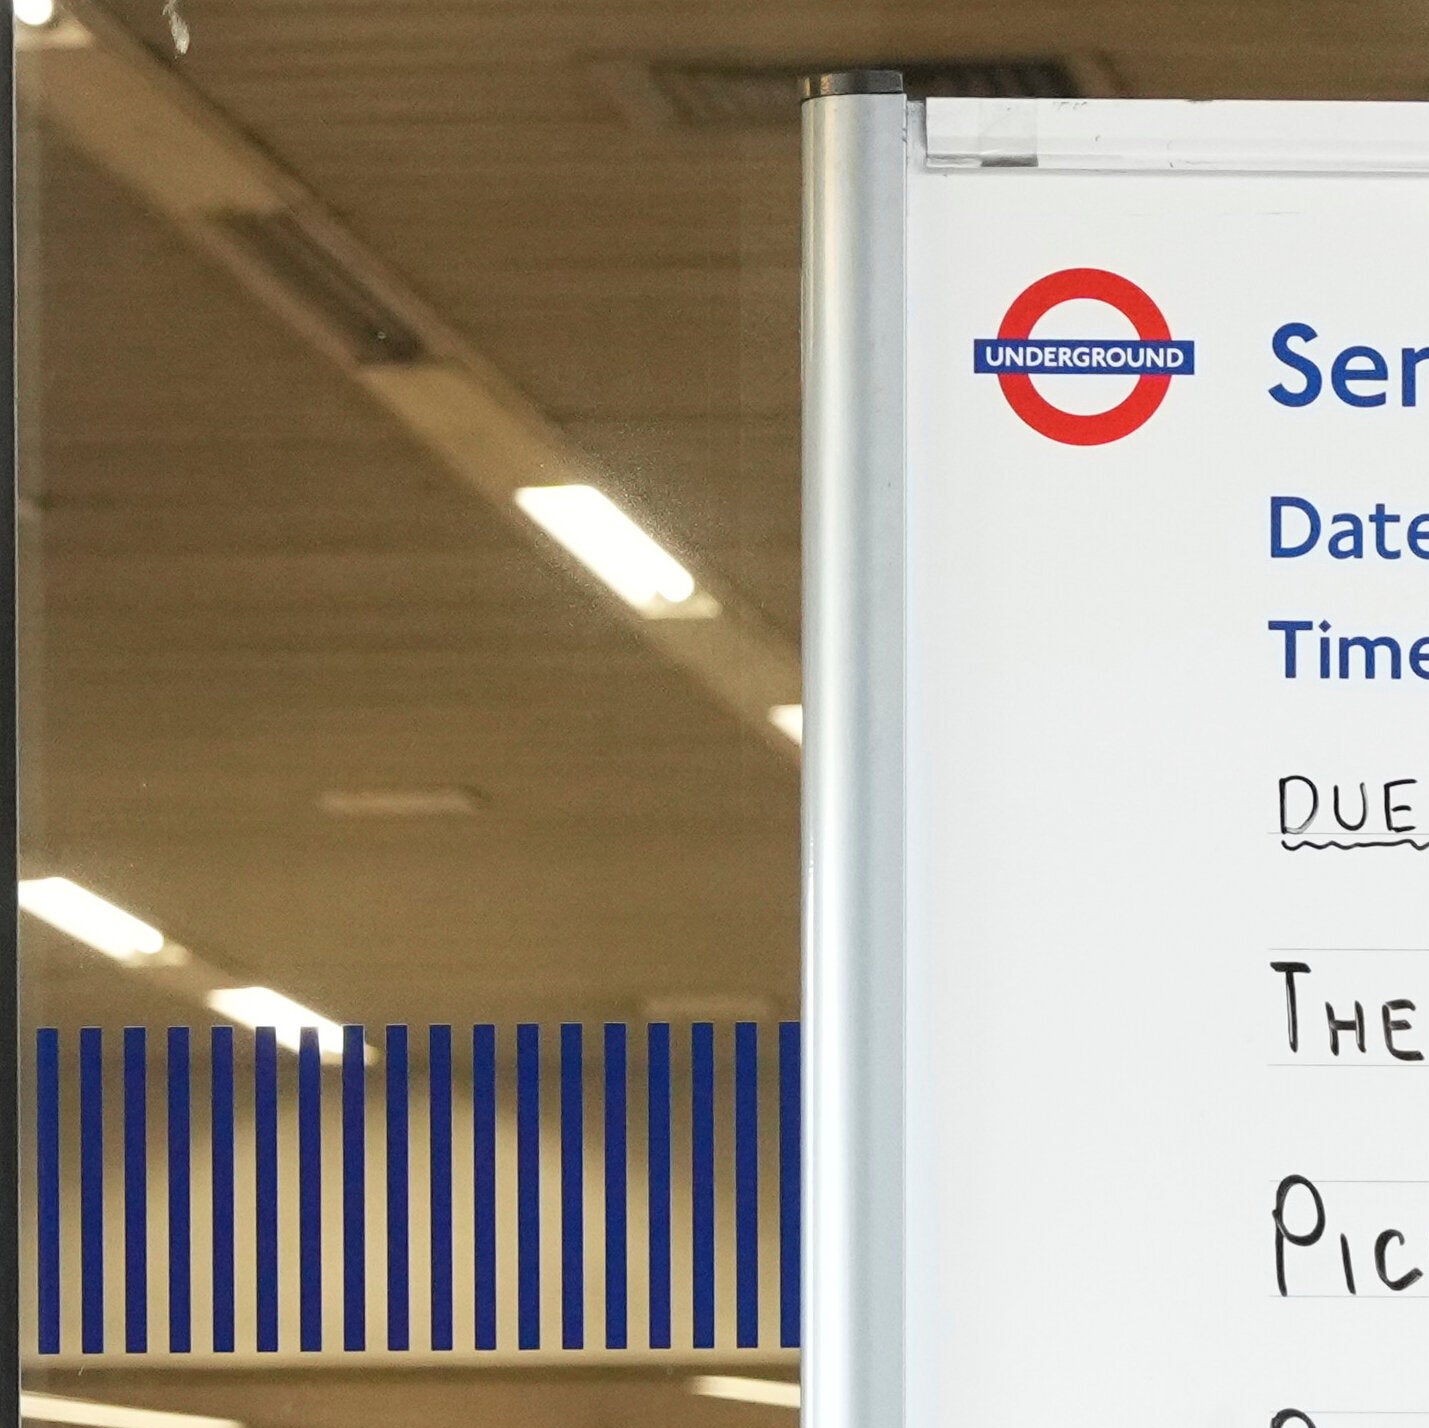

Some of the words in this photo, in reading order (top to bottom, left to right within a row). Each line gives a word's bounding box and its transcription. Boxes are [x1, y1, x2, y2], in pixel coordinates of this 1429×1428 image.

[986, 347, 1184, 367] UNDERGROUND
[1279, 775, 1417, 834] DUE
[1270, 962, 1424, 1061] THE
